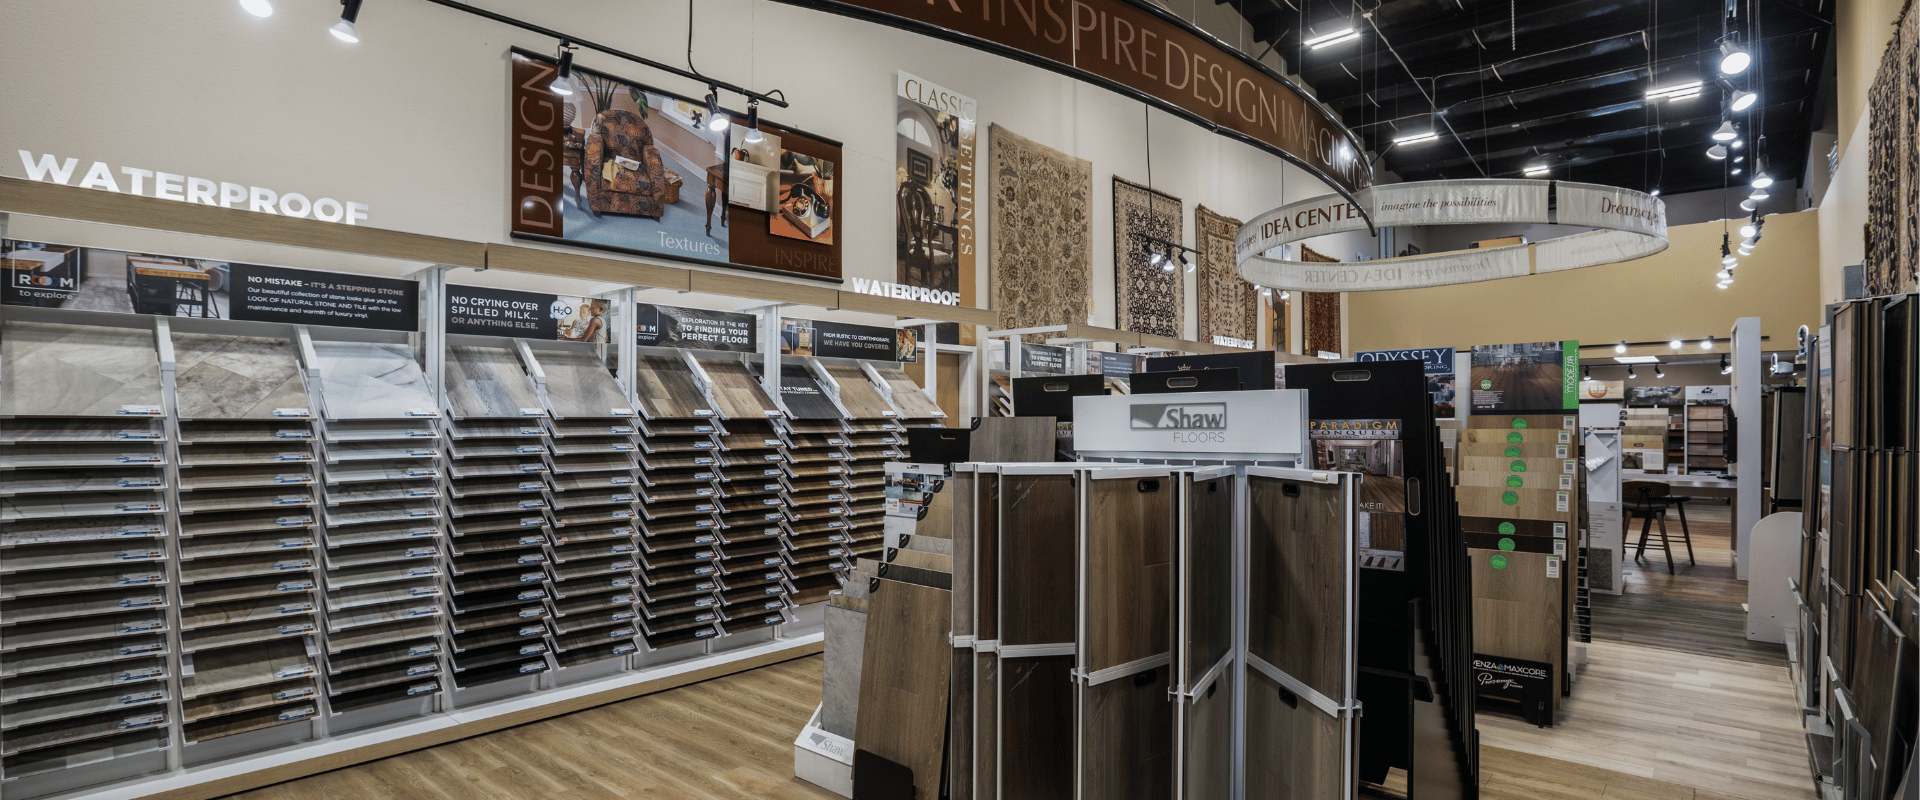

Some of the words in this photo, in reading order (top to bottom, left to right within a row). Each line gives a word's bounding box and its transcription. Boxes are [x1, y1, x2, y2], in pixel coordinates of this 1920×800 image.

[1166, 39, 1278, 134] DESIGN
[905, 79, 975, 123] CLASSIC
[520, 60, 555, 229] DESIGN
[18, 149, 369, 225] WATERPROOF
[1381, 200, 1421, 212] imagine
[1422, 198, 1438, 208] the
[1440, 197, 1497, 210] possibilities
[1261, 216, 1292, 240] IDEA
[1295, 202, 1362, 229] CENTE
[657, 230, 721, 256] Textures
[775, 247, 836, 273] INSPIRE
[19, 274, 74, 288] ROOM
[247, 275, 263, 283] NO
[264, 277, 303, 287] MISTAKE
[336, 284, 376, 294] STEPPING
[377, 288, 404, 296] STONE
[261, 288, 290, 296] beautiful
[290, 290, 320, 298] collection
[852, 277, 960, 307] WATERPROOF
[247, 295, 268, 303] LOOK
[281, 298, 313, 306] NATURAL
[314, 300, 337, 308] STONE
[247, 304, 288, 312] maintenance
[451, 295, 468, 305] NO
[470, 297, 510, 308] CRYING
[511, 301, 539, 311] OVER
[451, 305, 499, 317] SPILLED
[451, 316, 465, 325] OR
[466, 317, 514, 328] ANYTHING
[515, 321, 538, 330] ELSE.
[681, 317, 718, 326] EXPLORATION
[681, 324, 693, 332] TO
[694, 325, 726, 335] FINDING
[728, 328, 749, 336] YOUR
[681, 332, 719, 342] PERFECT
[721, 336, 749, 344] FLOOR
[864, 342, 890, 350] COVERED.
[1166, 406, 1223, 428] Shaw
[1310, 421, 1398, 430] PARADIGM
[1173, 431, 1225, 443] FLOORS
[1503, 664, 1547, 677] MAXCORE
[820, 739, 848, 757] Shaw
